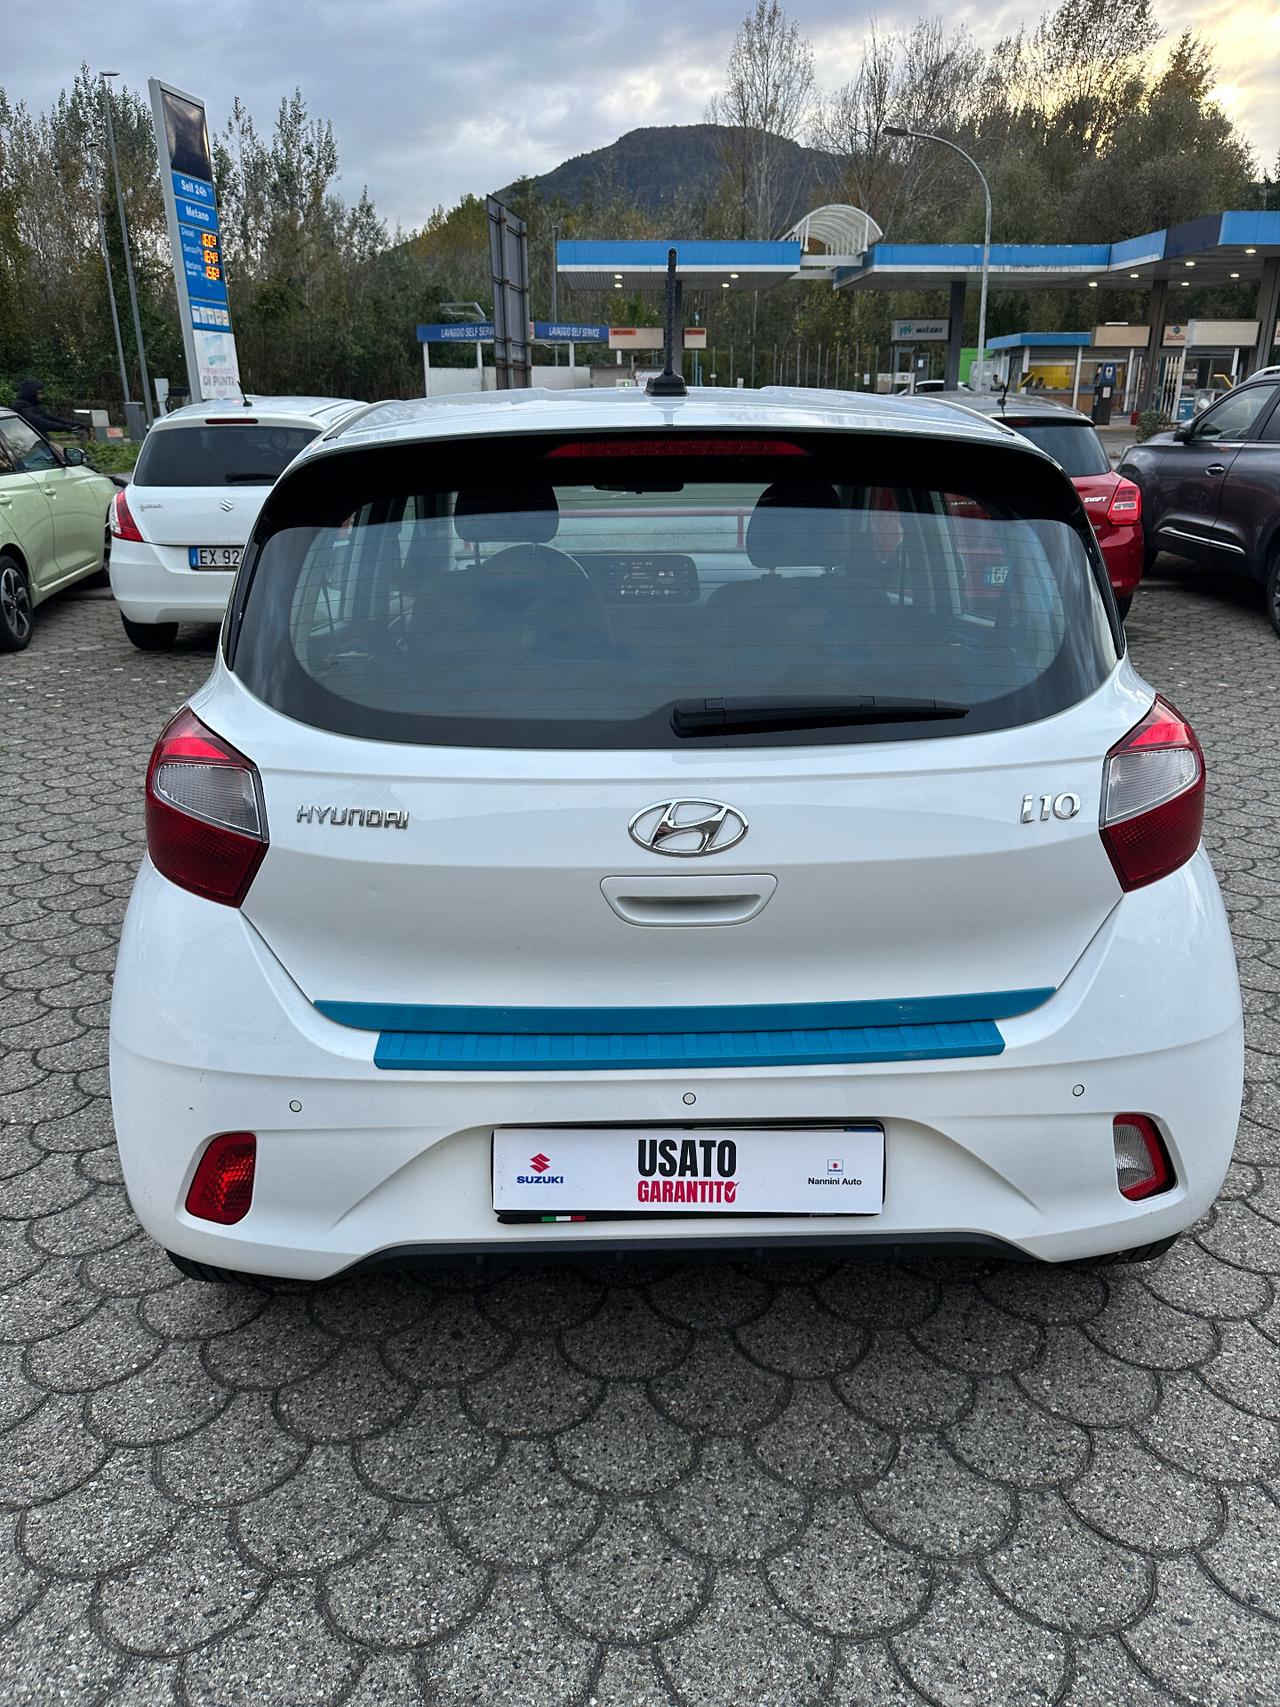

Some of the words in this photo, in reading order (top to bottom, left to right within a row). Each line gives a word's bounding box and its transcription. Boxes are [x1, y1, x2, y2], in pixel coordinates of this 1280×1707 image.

[186, 205, 209, 221] Metano
[441, 328, 465, 338] LAVAGGIO
[465, 327, 479, 337] SELF
[549, 325, 571, 337] LAVAGGIO
[581, 327, 600, 338] SERVICE
[200, 549, 217, 565] EX
[223, 550, 240, 565] 92
[1020, 792, 1081, 824] i10
[296, 805, 410, 830] HYUNDAI
[637, 1139, 737, 1178] USATO
[516, 1175, 564, 1184] SUZUKI
[807, 1177, 840, 1185] Nannini
[841, 1178, 862, 1186] Auto
[637, 1180, 740, 1204] GARANTITO
